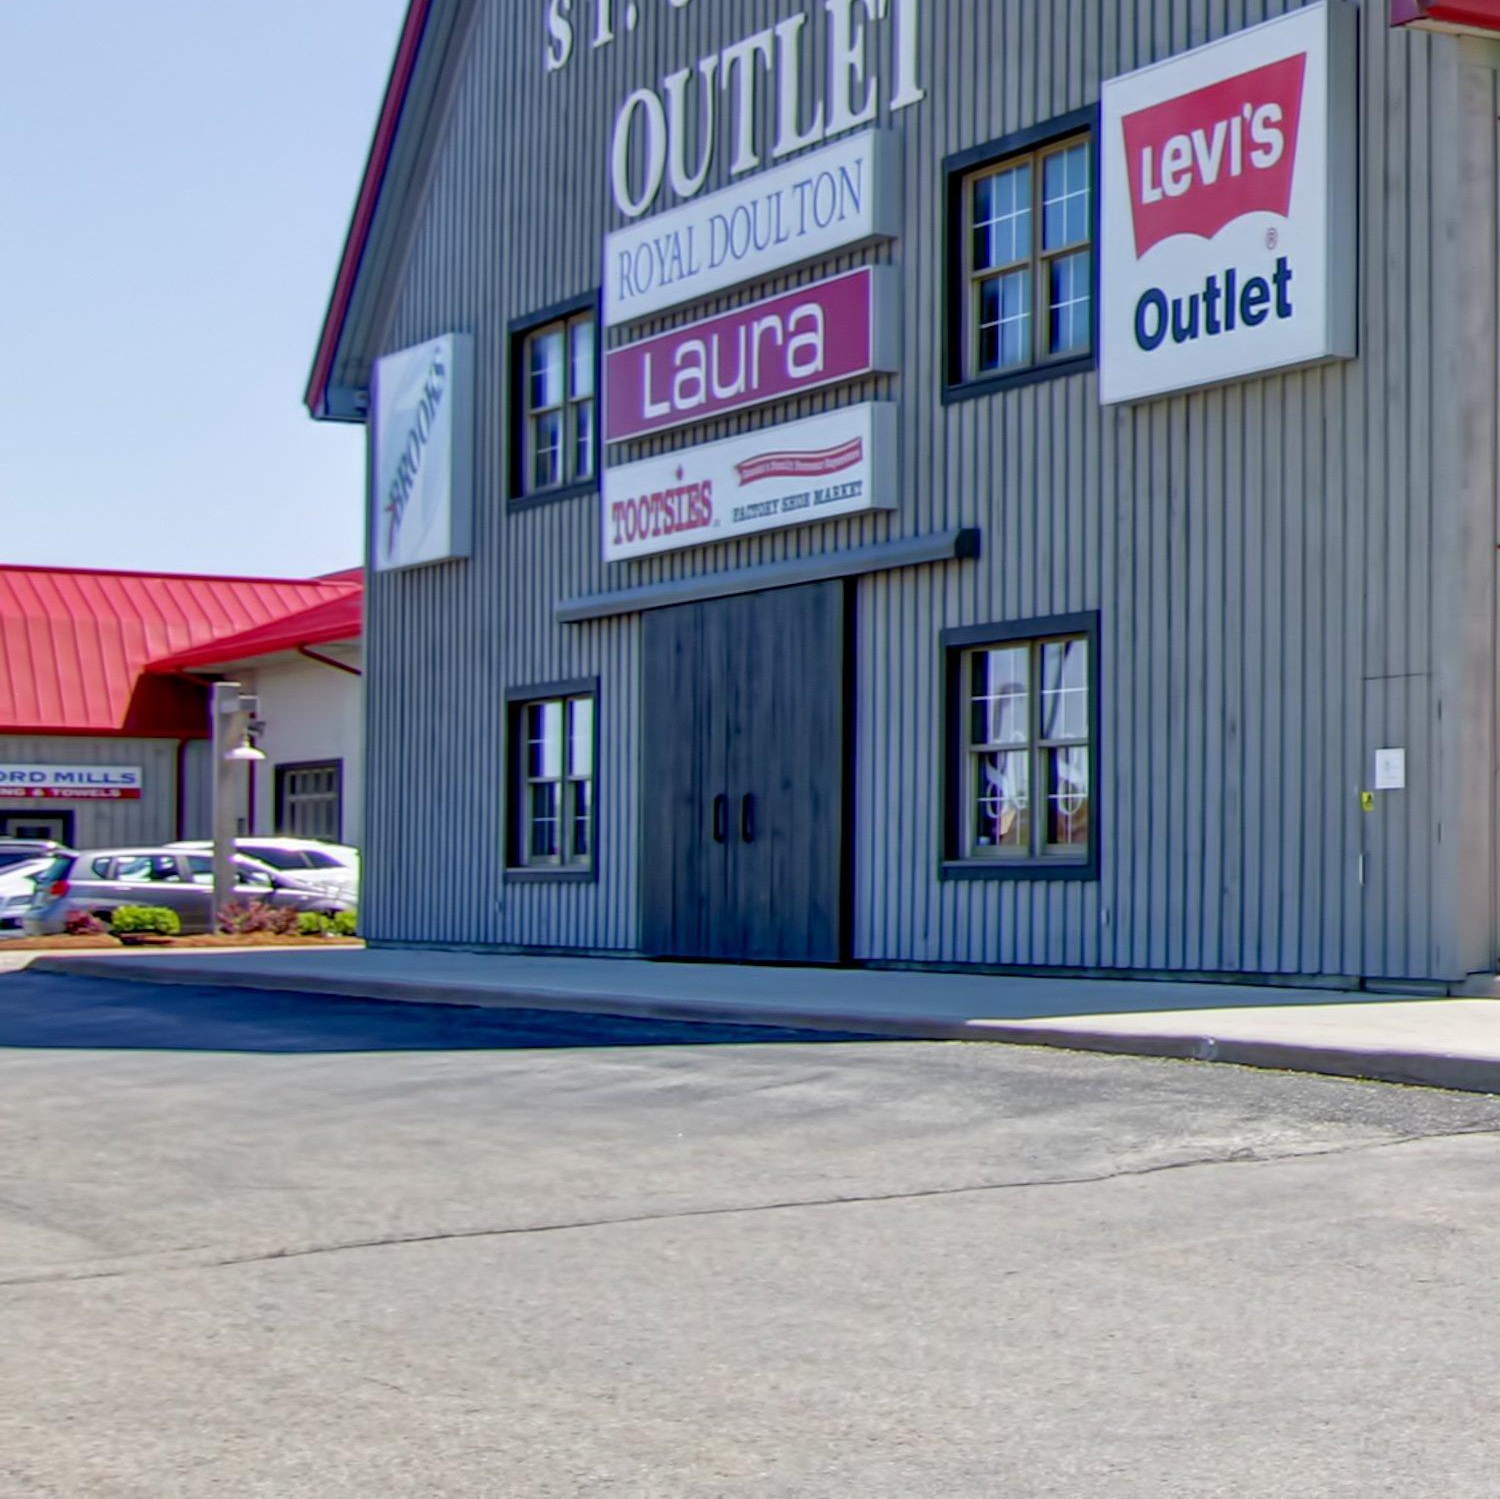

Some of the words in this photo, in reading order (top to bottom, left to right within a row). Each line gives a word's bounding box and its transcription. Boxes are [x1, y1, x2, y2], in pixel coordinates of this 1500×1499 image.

[618, 225, 700, 301] ROYAL
[708, 159, 863, 269] DOULTON
[1134, 256, 1294, 352] Outlet
[642, 302, 826, 420] Laura
[611, 478, 714, 546] TOOTSIES
[733, 498, 780, 522] FACTORY
[781, 492, 811, 513] SHOE
[813, 480, 863, 506] MARKET
[54, 771, 136, 784] MILLS
